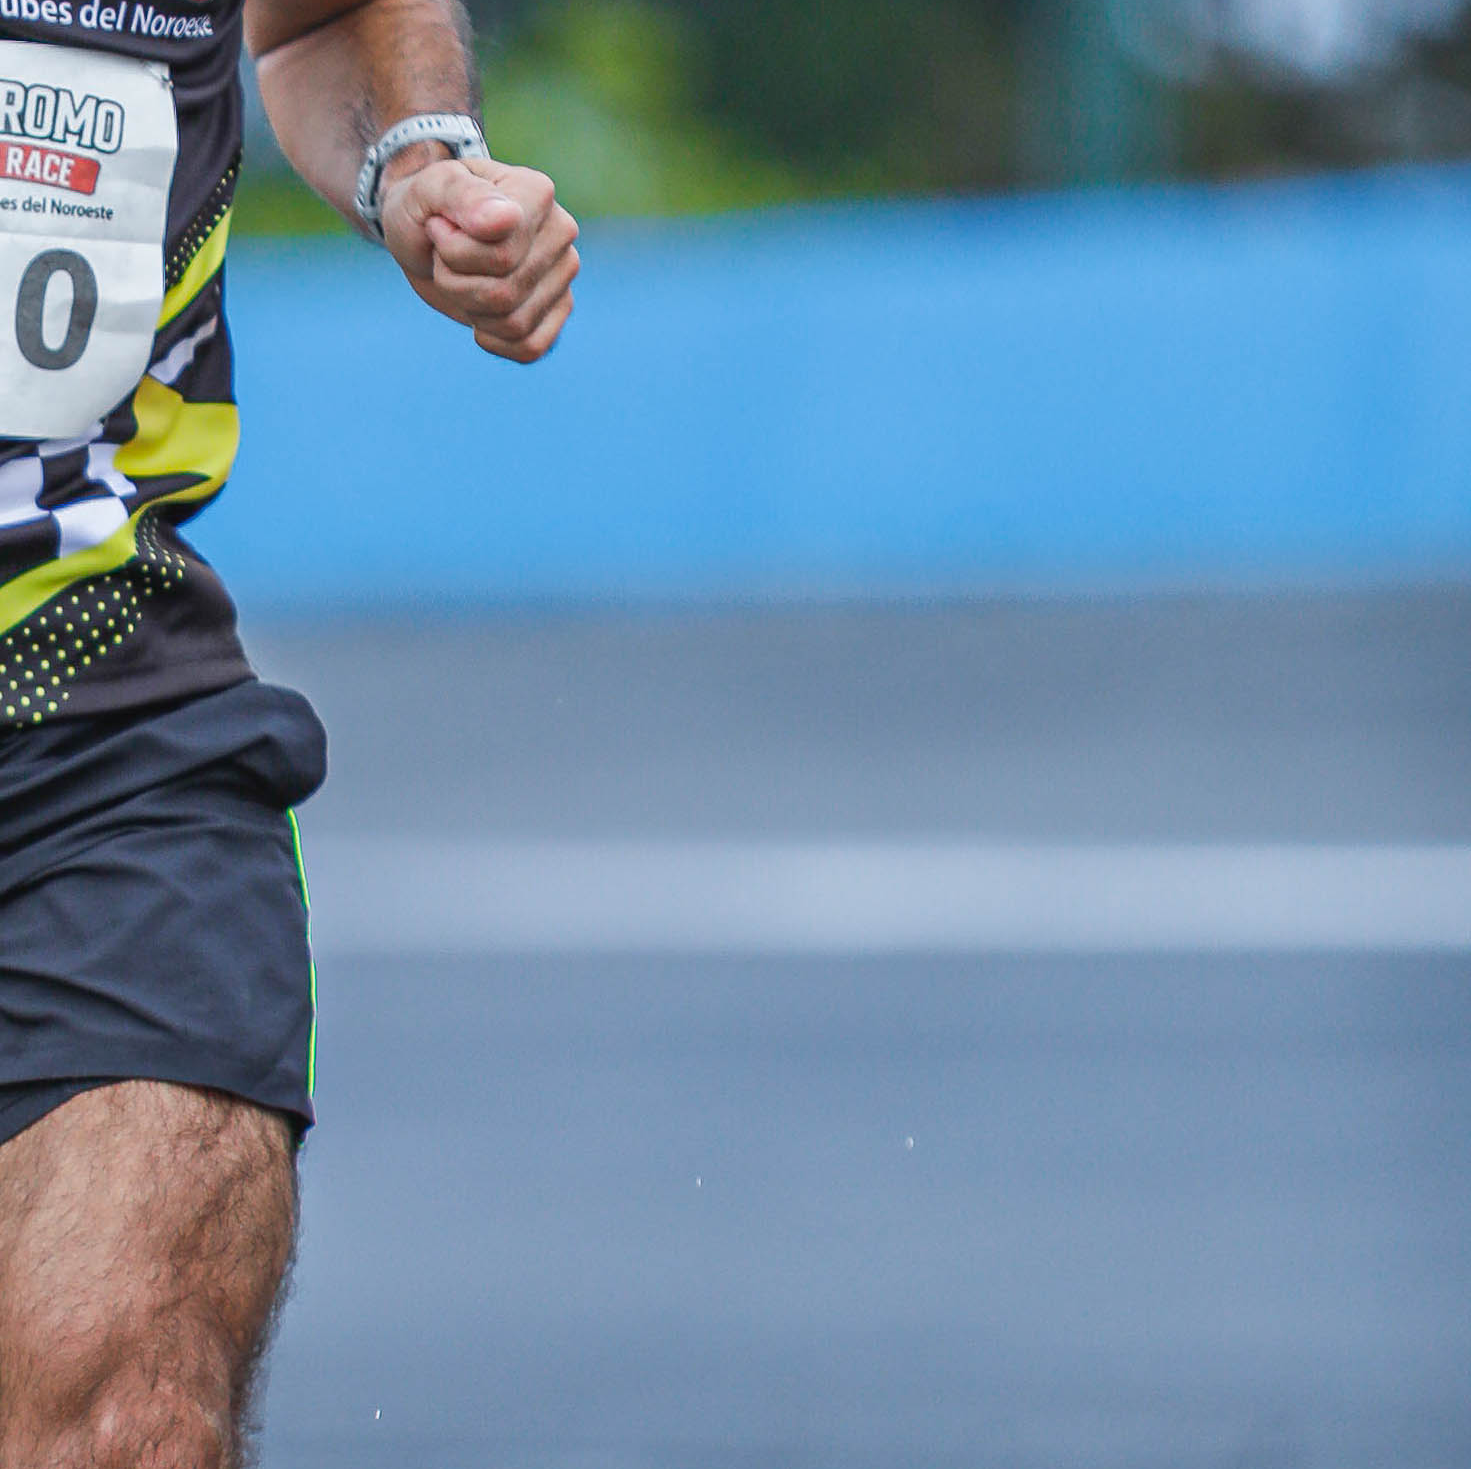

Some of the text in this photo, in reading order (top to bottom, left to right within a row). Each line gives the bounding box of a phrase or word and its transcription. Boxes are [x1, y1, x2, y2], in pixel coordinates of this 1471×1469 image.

[6, 146, 77, 187] RACE
[22, 195, 46, 213] del
[50, 198, 114, 221] Noroeste
